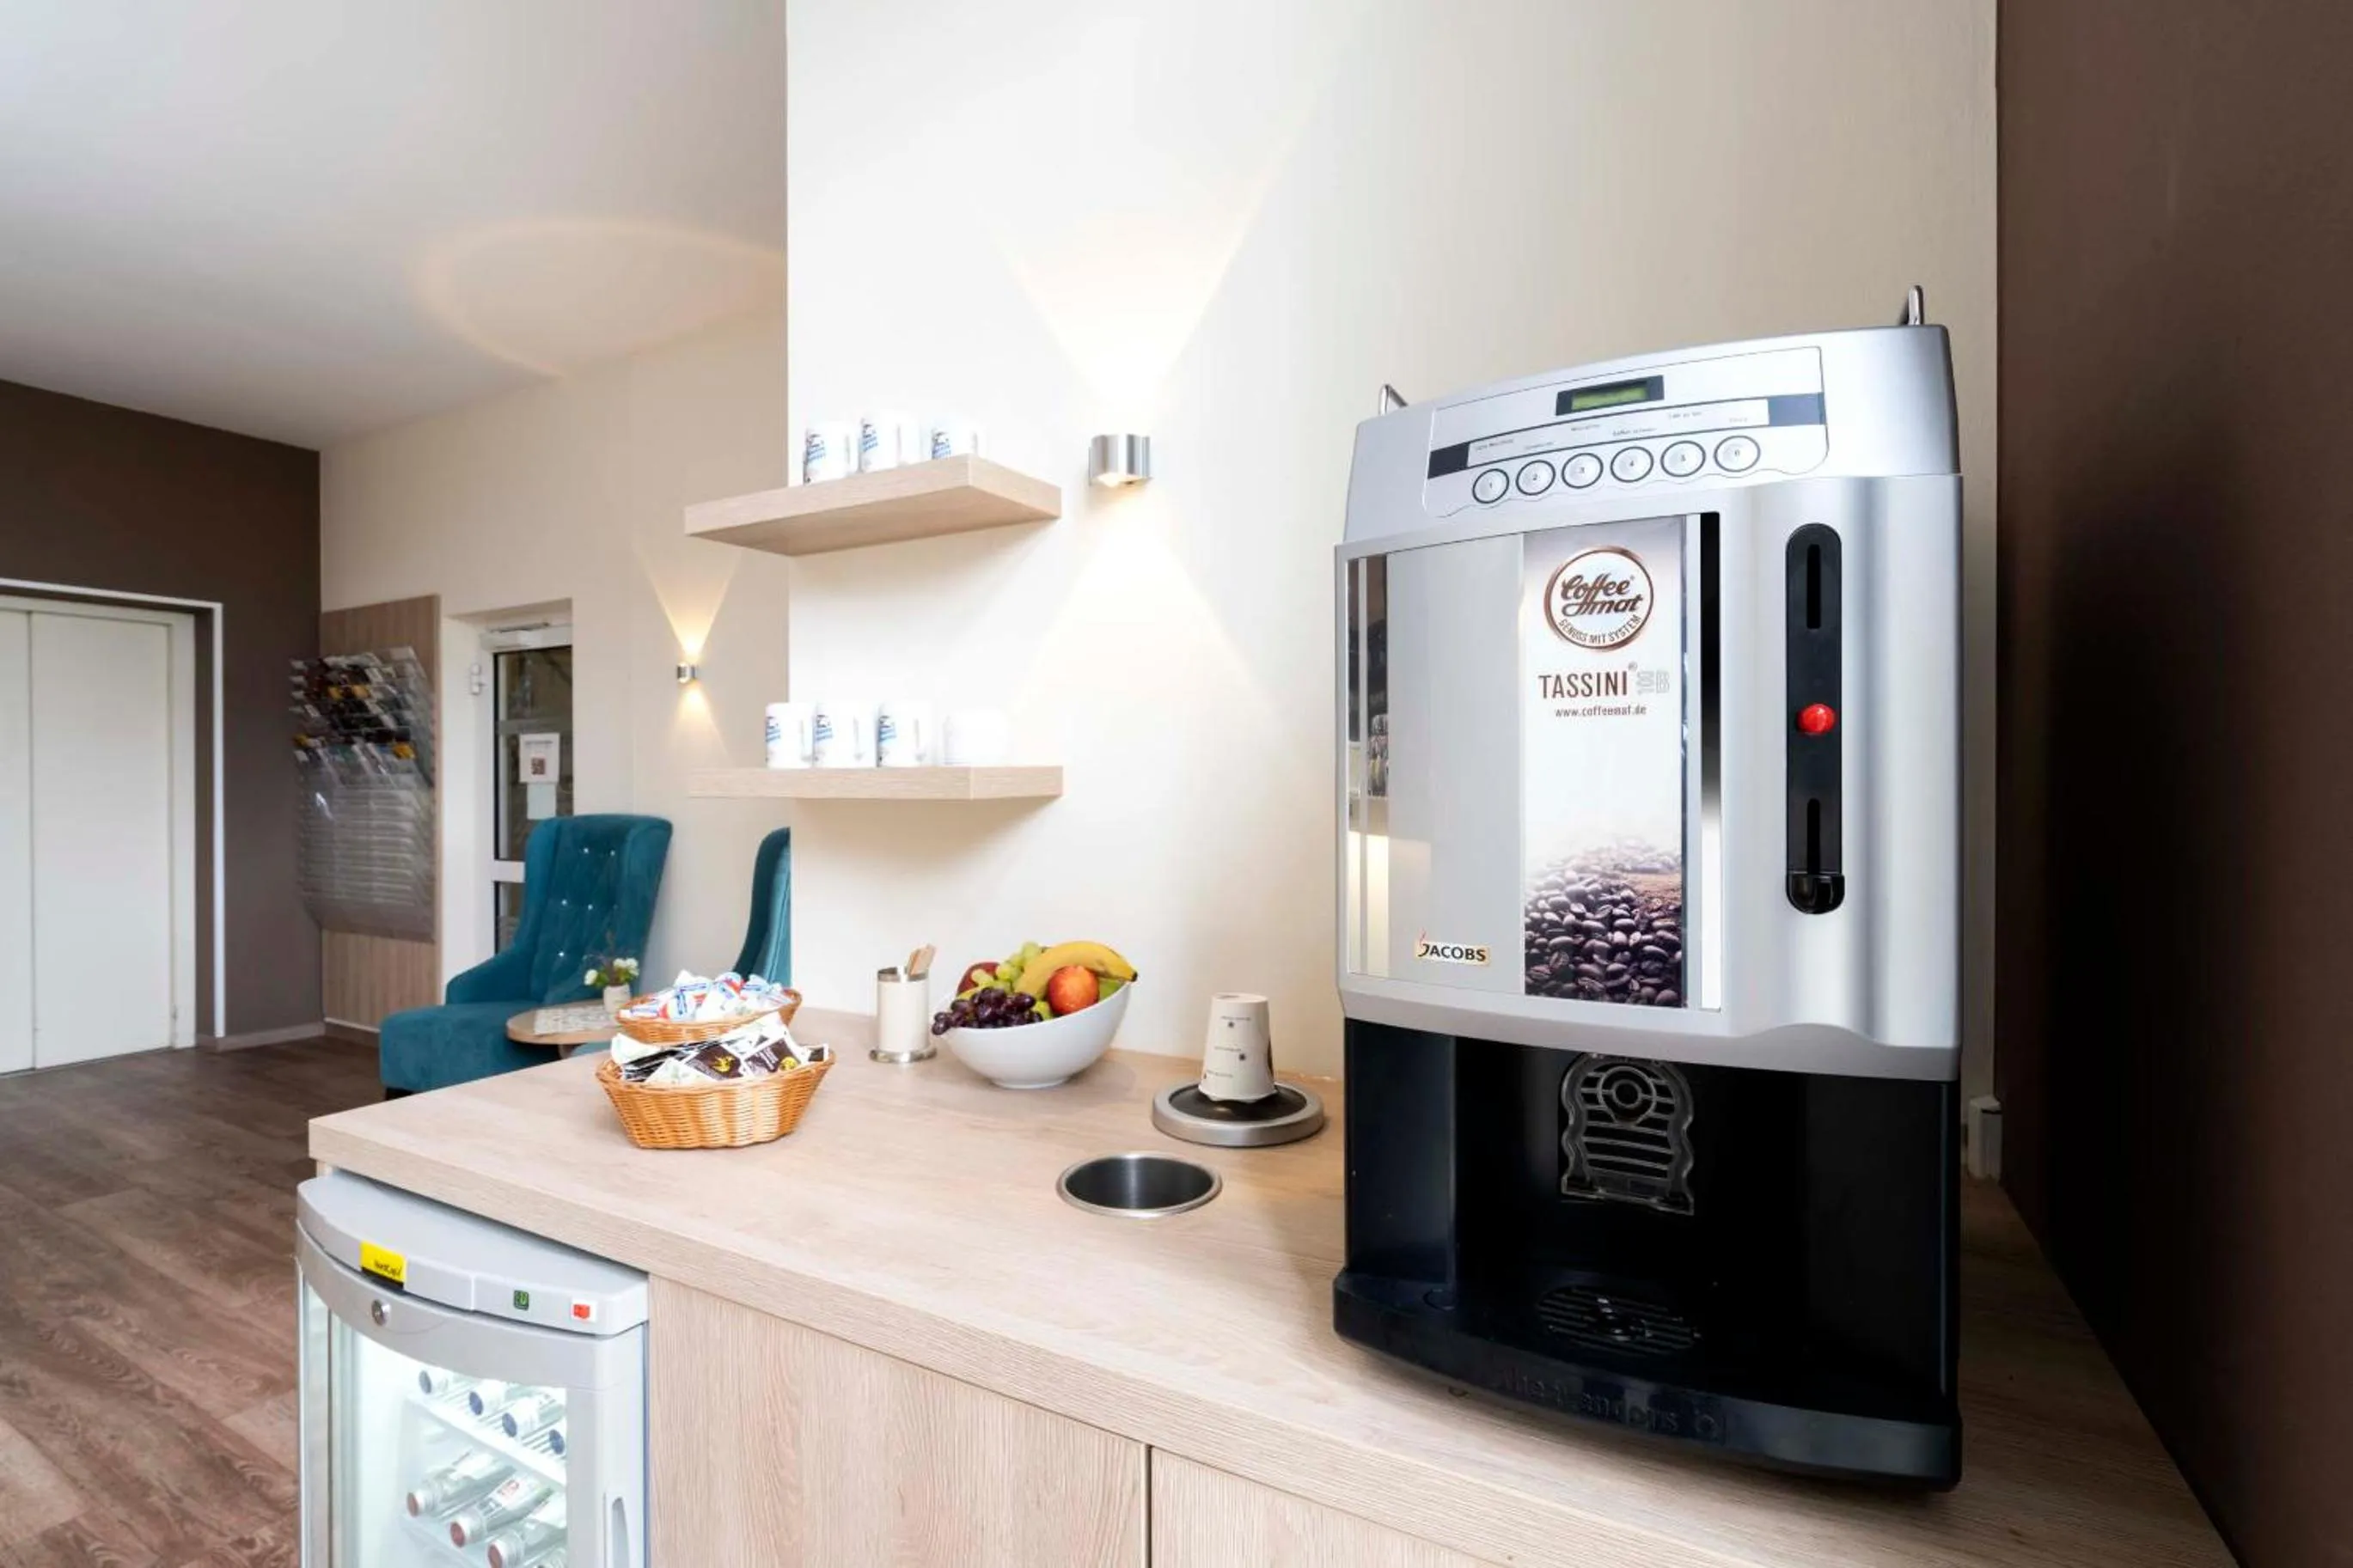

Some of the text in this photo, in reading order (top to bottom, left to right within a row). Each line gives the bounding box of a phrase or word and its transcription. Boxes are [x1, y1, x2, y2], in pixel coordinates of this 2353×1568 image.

[1560, 572, 1631, 605] Coffee
[1559, 613, 1641, 644] GENUSS MIT SYSTEM
[1538, 670, 1629, 699] TASSINI
[1555, 705, 1647, 717] www.coffeemat.de
[1417, 943, 1487, 961] JACOBS
